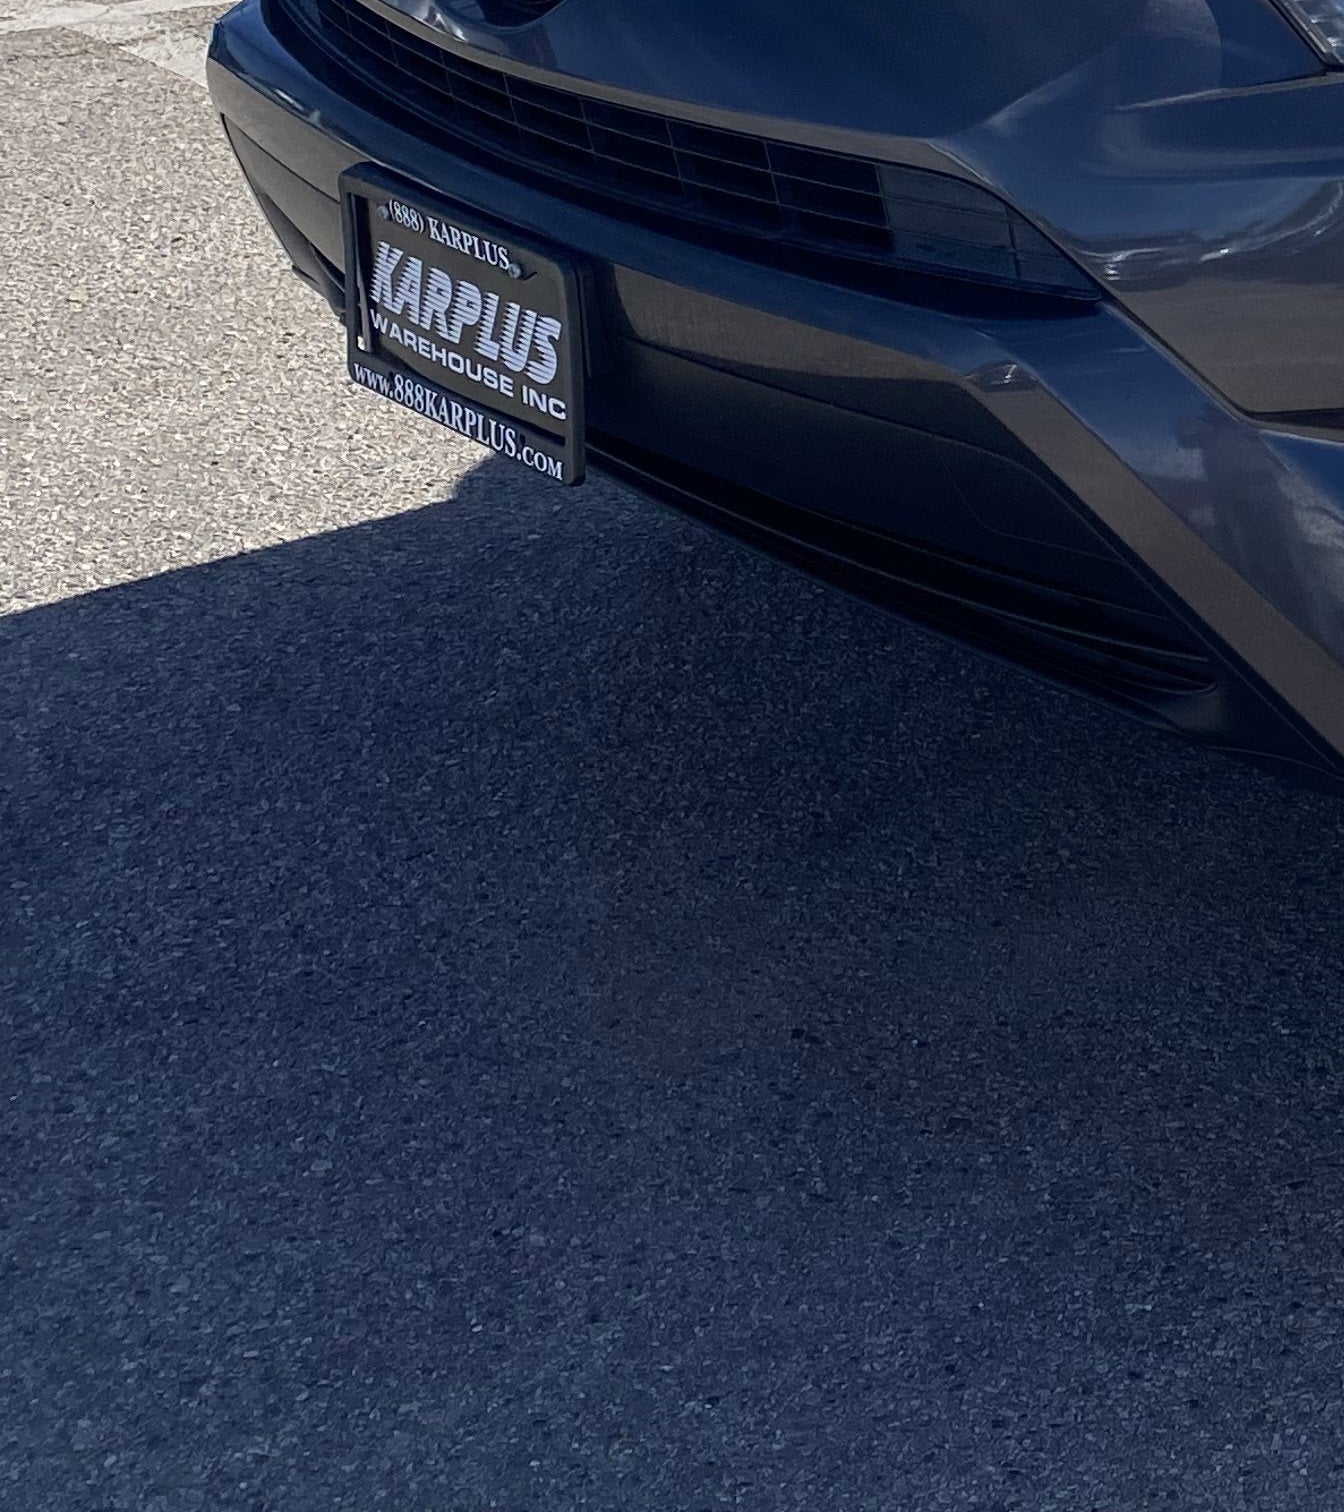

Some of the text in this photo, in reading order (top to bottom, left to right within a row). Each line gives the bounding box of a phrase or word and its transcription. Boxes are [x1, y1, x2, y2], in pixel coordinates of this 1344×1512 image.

[388, 198, 510, 271] (888) KARPLUS
[369, 240, 562, 385] KARPLUS
[370, 308, 567, 420] WAREHOUSE INC
